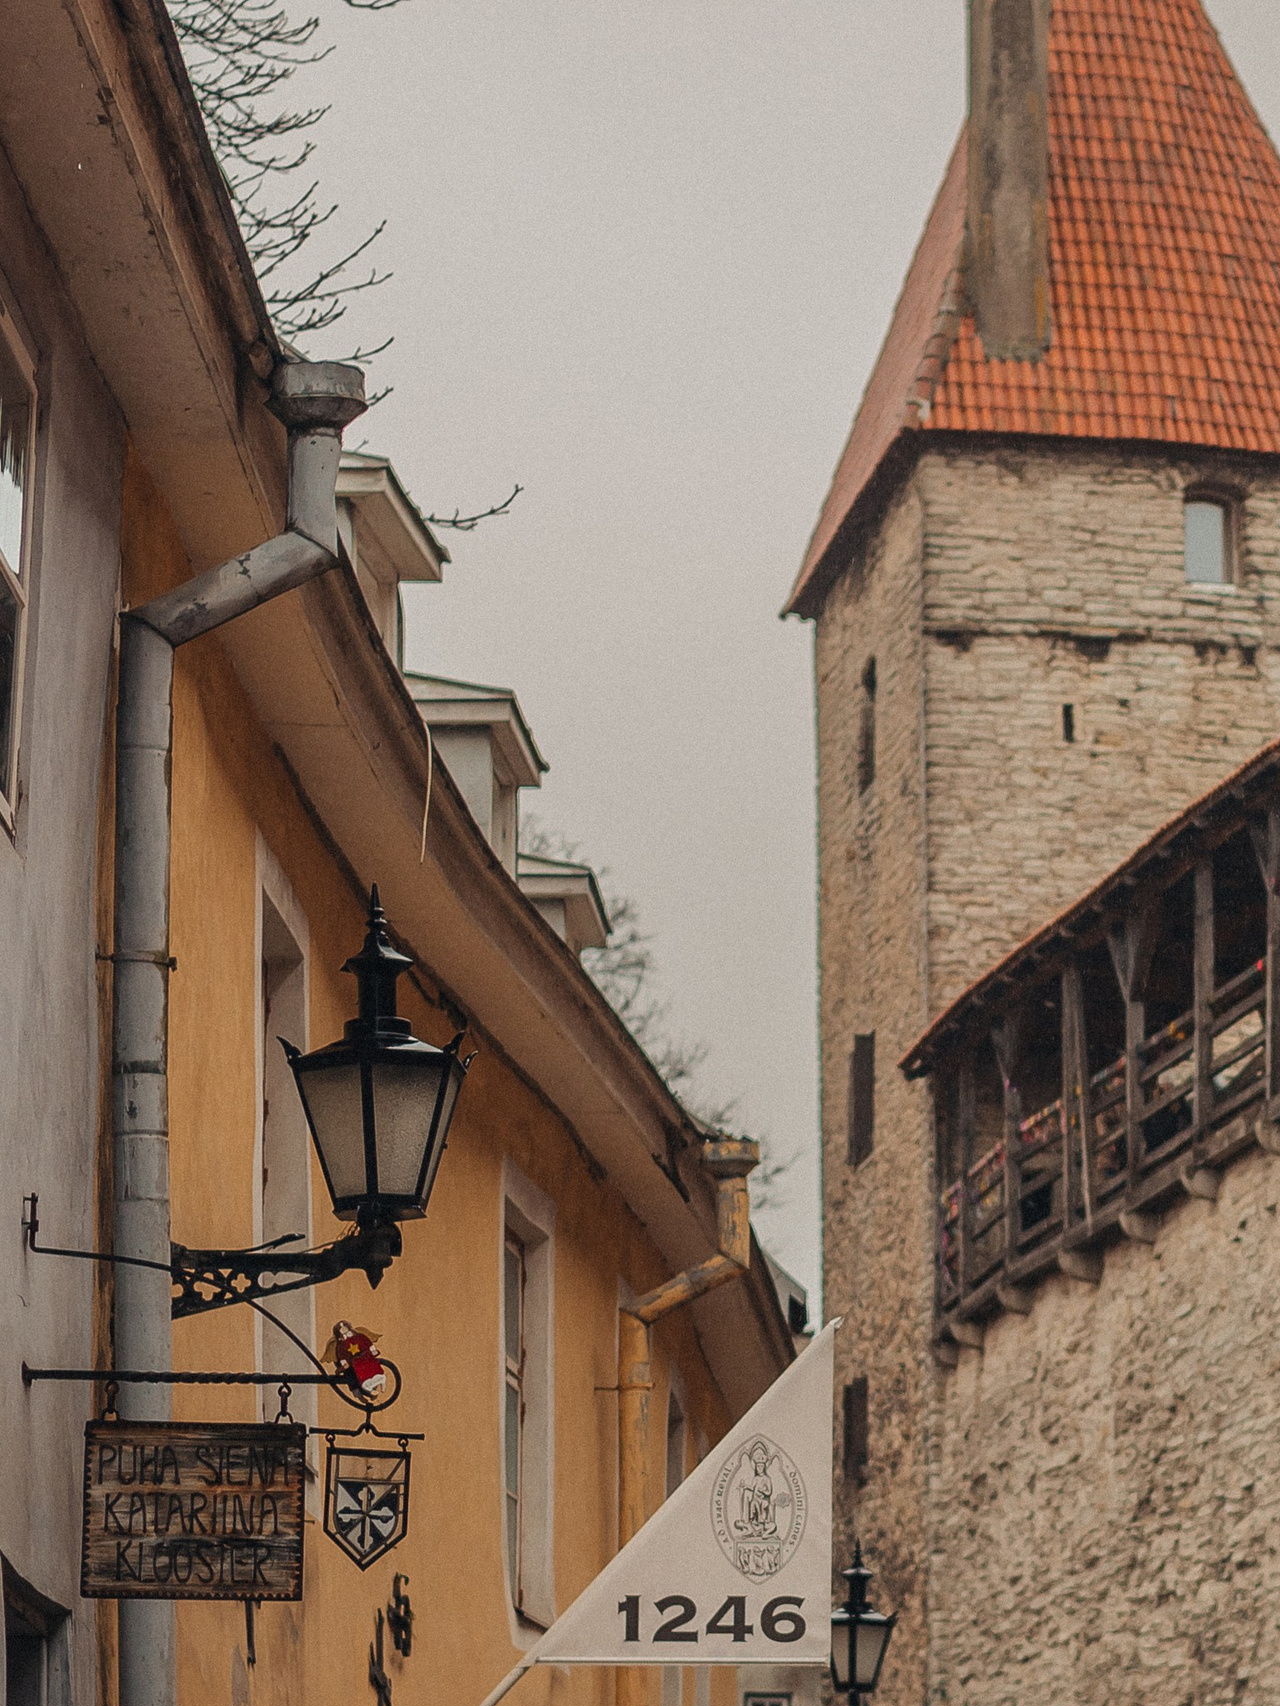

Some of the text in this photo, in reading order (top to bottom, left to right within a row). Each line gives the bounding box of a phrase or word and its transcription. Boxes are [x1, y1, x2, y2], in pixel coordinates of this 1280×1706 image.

[195, 1446, 290, 1487] SIENA
[104, 1491, 279, 1535] KATARIINA
[115, 1539, 270, 1585] KLOOSTER
[617, 1594, 807, 1644] 1246
